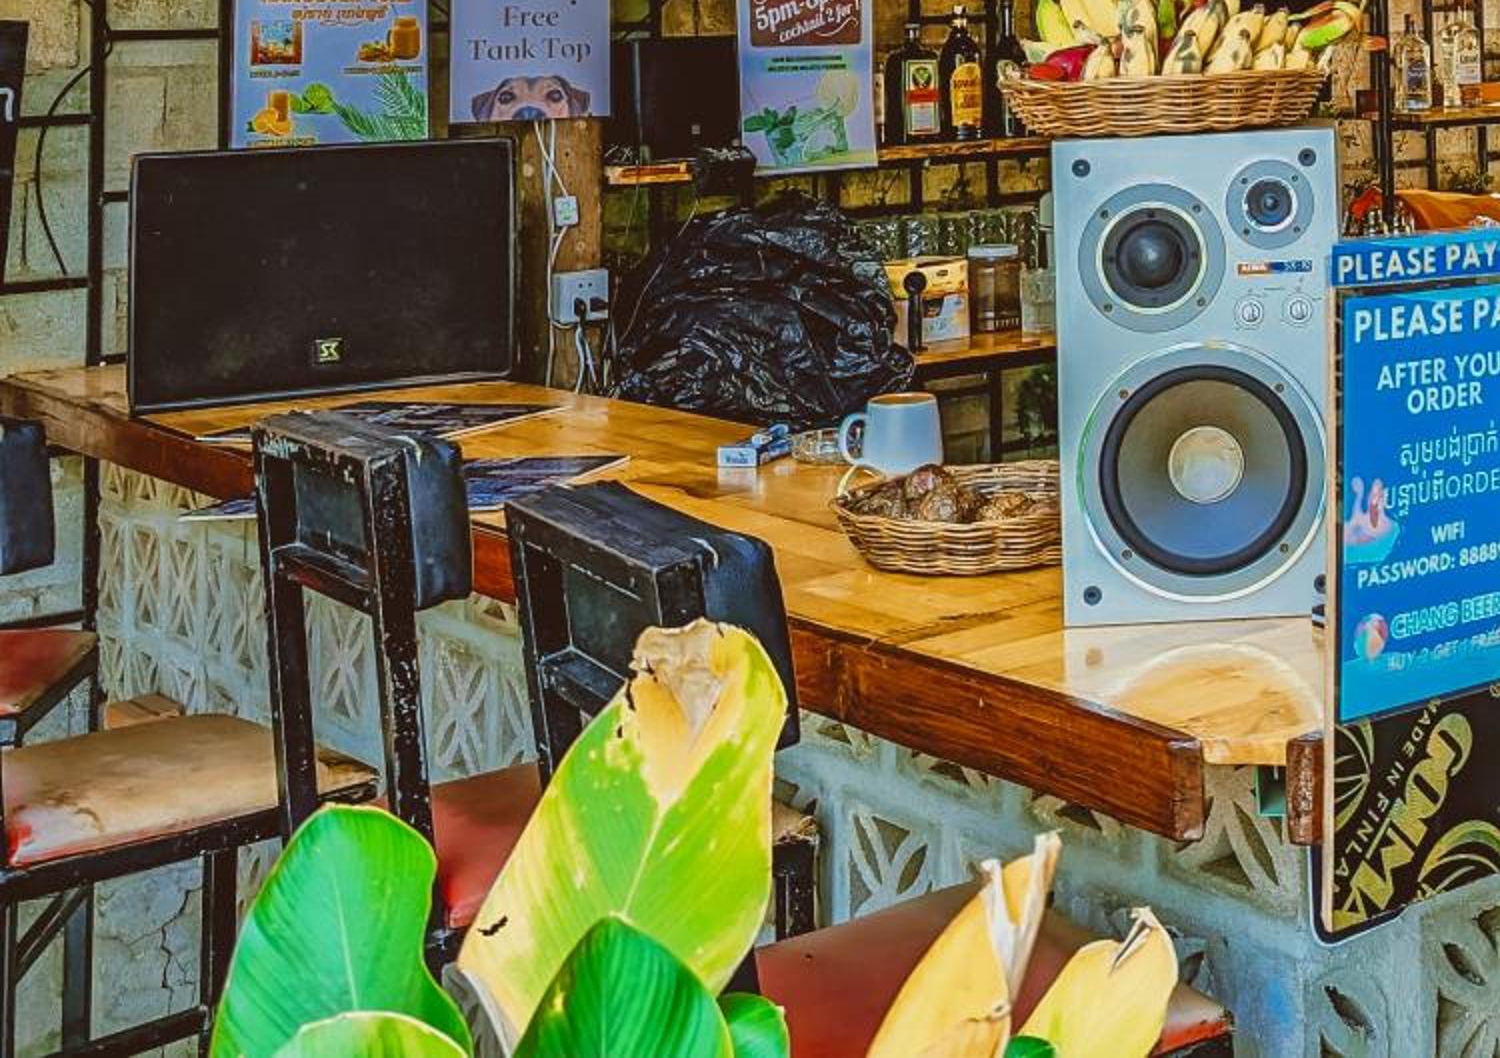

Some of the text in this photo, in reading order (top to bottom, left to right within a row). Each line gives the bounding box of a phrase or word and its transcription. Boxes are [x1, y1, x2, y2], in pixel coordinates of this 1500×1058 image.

[503, 5, 560, 28] Free
[825, 7, 835, 23] 2
[468, 37, 593, 63] Tank Top
[1337, 240, 1500, 284] PLEASE PAY
[1353, 300, 1464, 344] PLEASE
[1376, 357, 1448, 392] AFTER
[1406, 381, 1484, 415] ORDER
[1430, 520, 1466, 545] WIFI
[1357, 552, 1456, 591] PASSWORD:
[1389, 601, 1459, 640] CHANG
[1386, 760, 1405, 788] IN
[1333, 790, 1391, 892] FINLA
